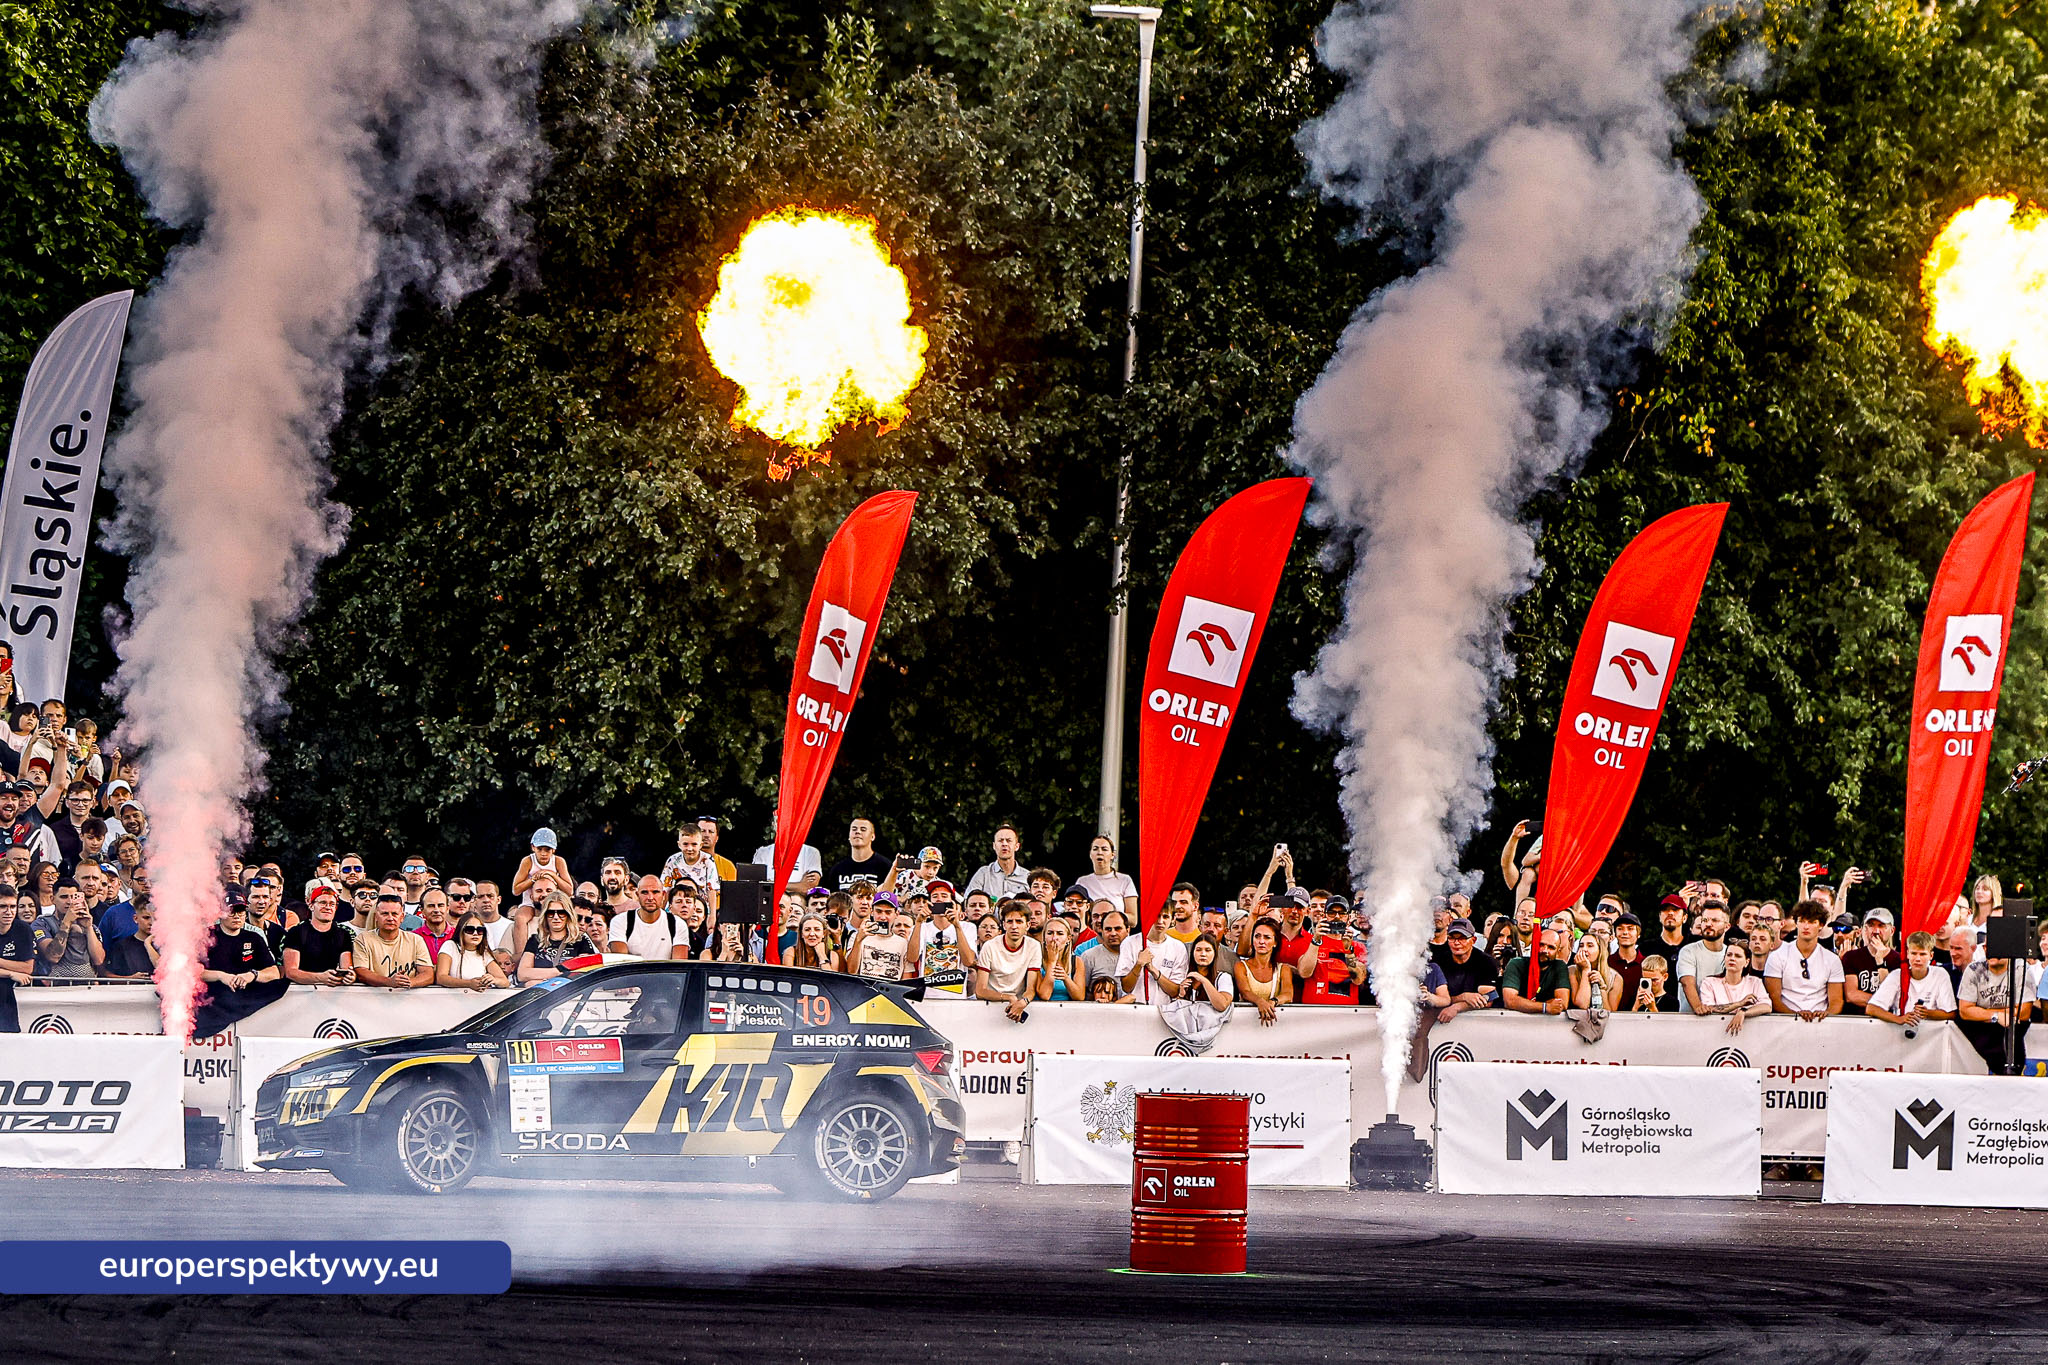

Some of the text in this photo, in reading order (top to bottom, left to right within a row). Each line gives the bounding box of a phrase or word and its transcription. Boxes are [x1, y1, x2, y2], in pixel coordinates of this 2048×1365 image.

[0, 408, 93, 641] Śląskie.
[1171, 724, 1200, 747] OIL
[1594, 748, 1625, 770] OIL
[740, 1004, 781, 1015] Kołtun
[797, 995, 831, 1026] 19
[740, 1014, 784, 1026] Pleskot
[792, 1034, 911, 1048] ENERGY. NOW!
[511, 1041, 533, 1063] 19
[960, 1074, 1011, 1094] ADION
[1766, 1090, 1827, 1109] STADIO
[0, 1115, 115, 1130] IZJA
[1582, 1107, 1671, 1123] Górnośląsko
[1968, 1117, 2048, 1135] Górnośląsk
[1582, 1141, 1661, 1156] Metropolia
[1967, 1152, 2044, 1168] Metropolia
[1173, 1176, 1215, 1187] ORLEN
[1173, 1188, 1190, 1197] OIL
